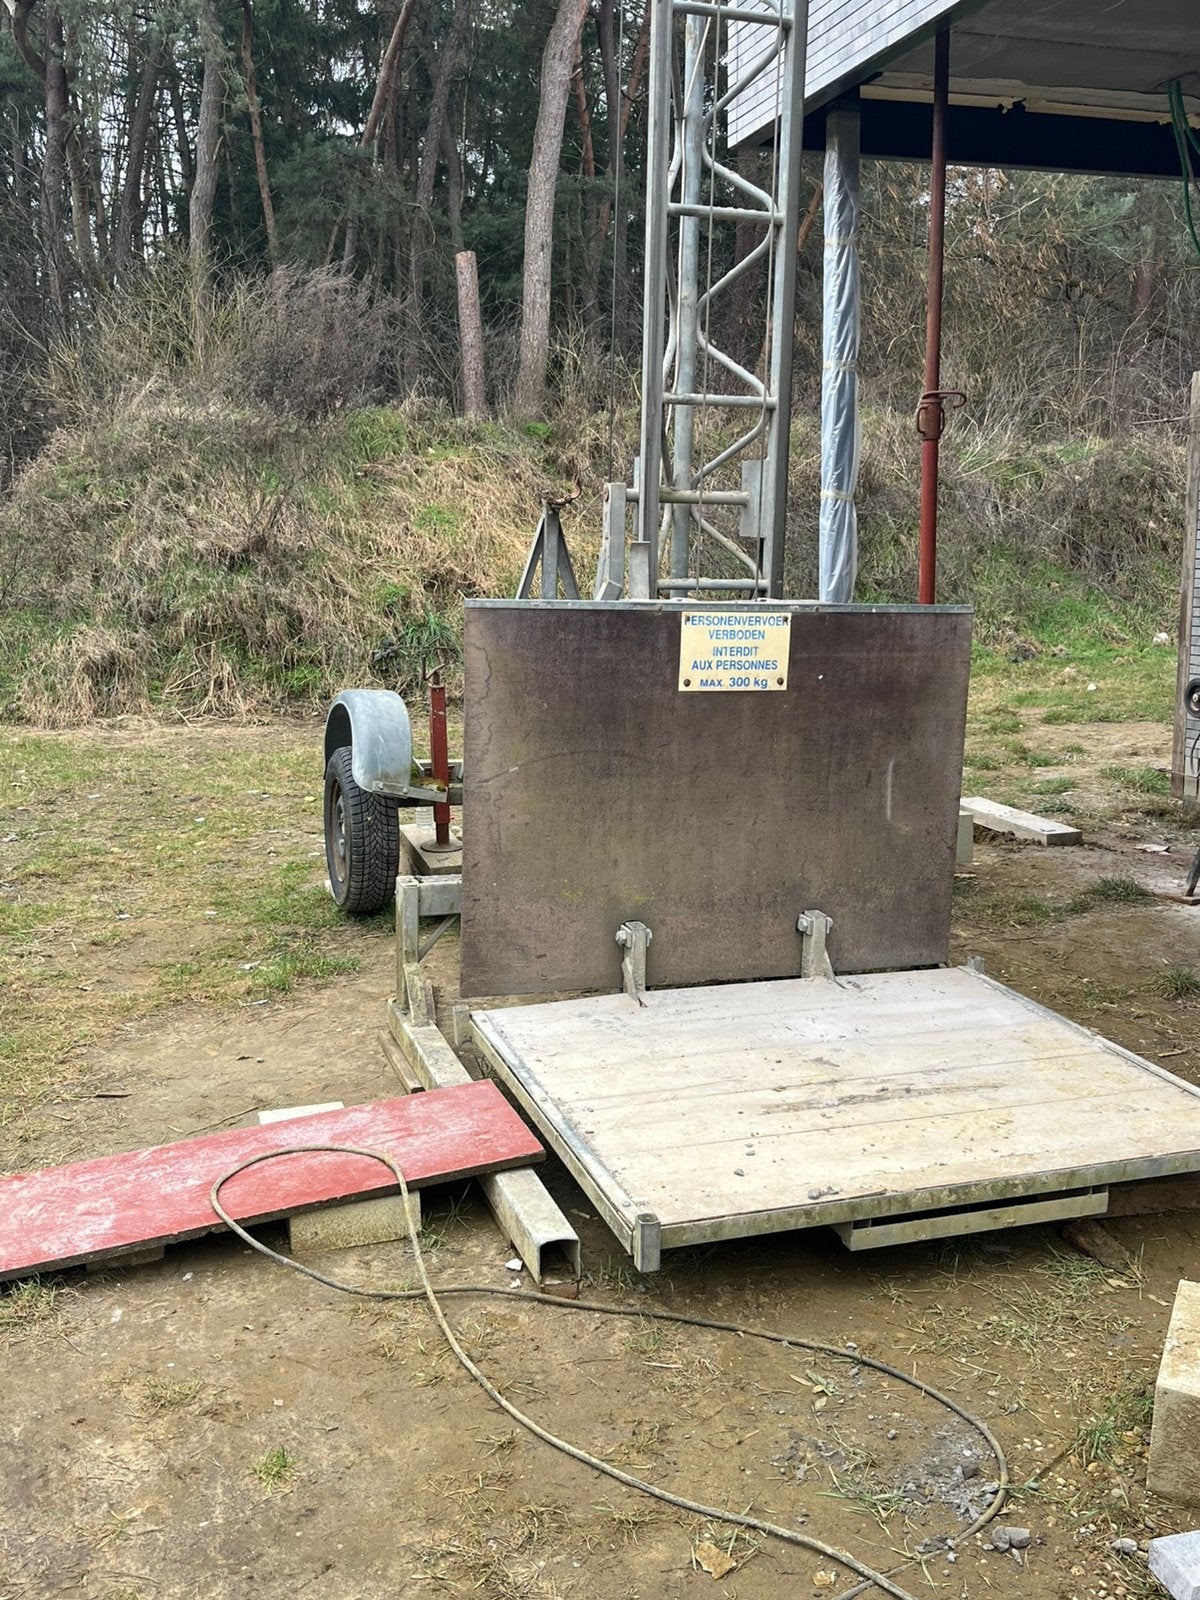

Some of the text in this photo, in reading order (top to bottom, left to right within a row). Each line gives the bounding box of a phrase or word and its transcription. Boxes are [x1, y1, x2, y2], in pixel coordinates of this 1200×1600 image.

[709, 630, 765, 640] VERBODEN
[712, 646, 759, 657] INTERDIT
[691, 660, 778, 671] AUX PERSONNES
[729, 677, 750, 688] 300
[754, 677, 768, 689] kg
